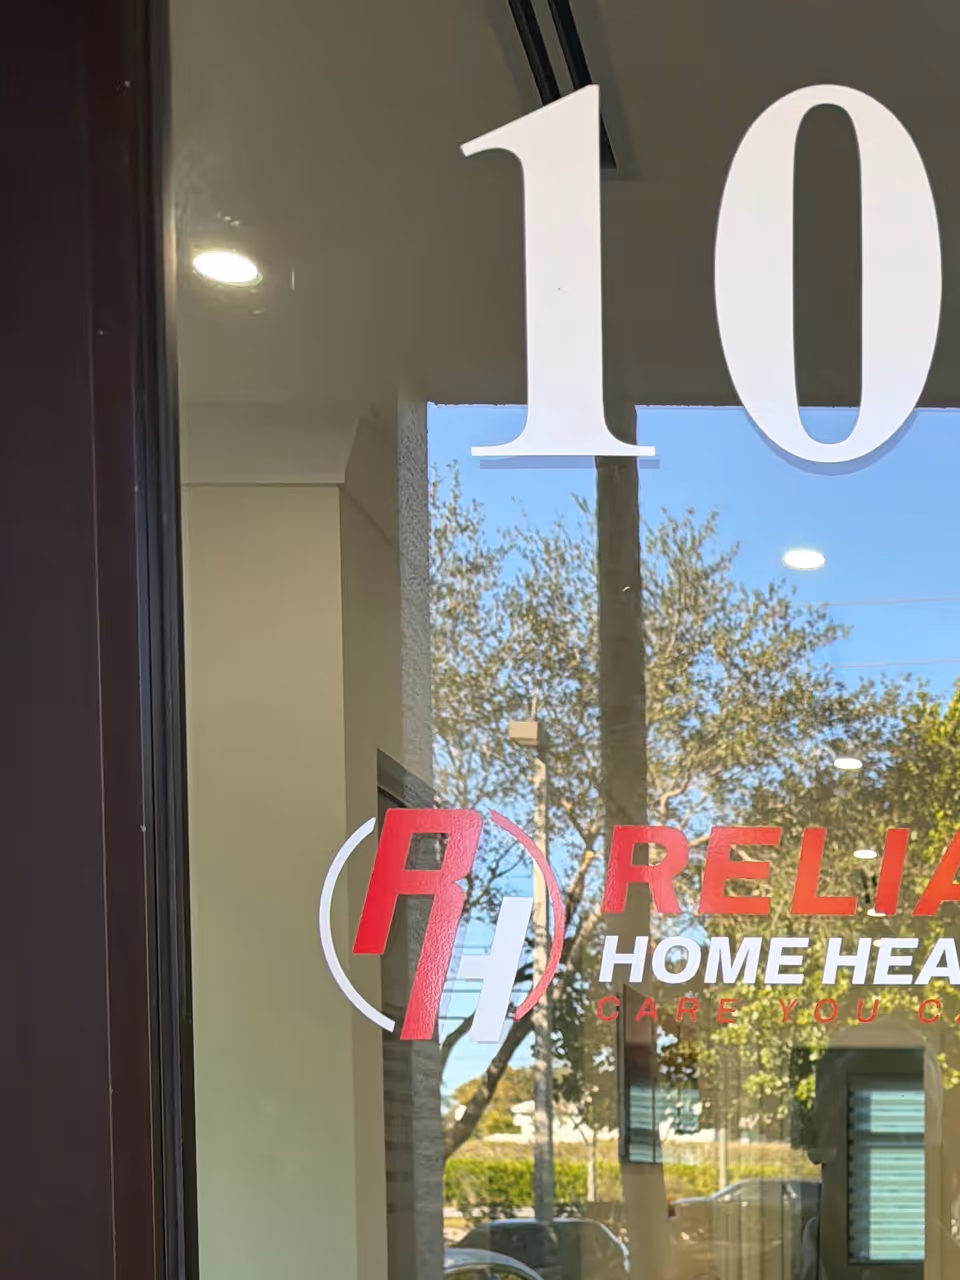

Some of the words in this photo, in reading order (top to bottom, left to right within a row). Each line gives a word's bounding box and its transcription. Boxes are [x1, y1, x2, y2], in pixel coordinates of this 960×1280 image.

[598, 935, 810, 987] HOME
[597, 996, 737, 1024] CARE
[778, 997, 881, 1023] YOU
